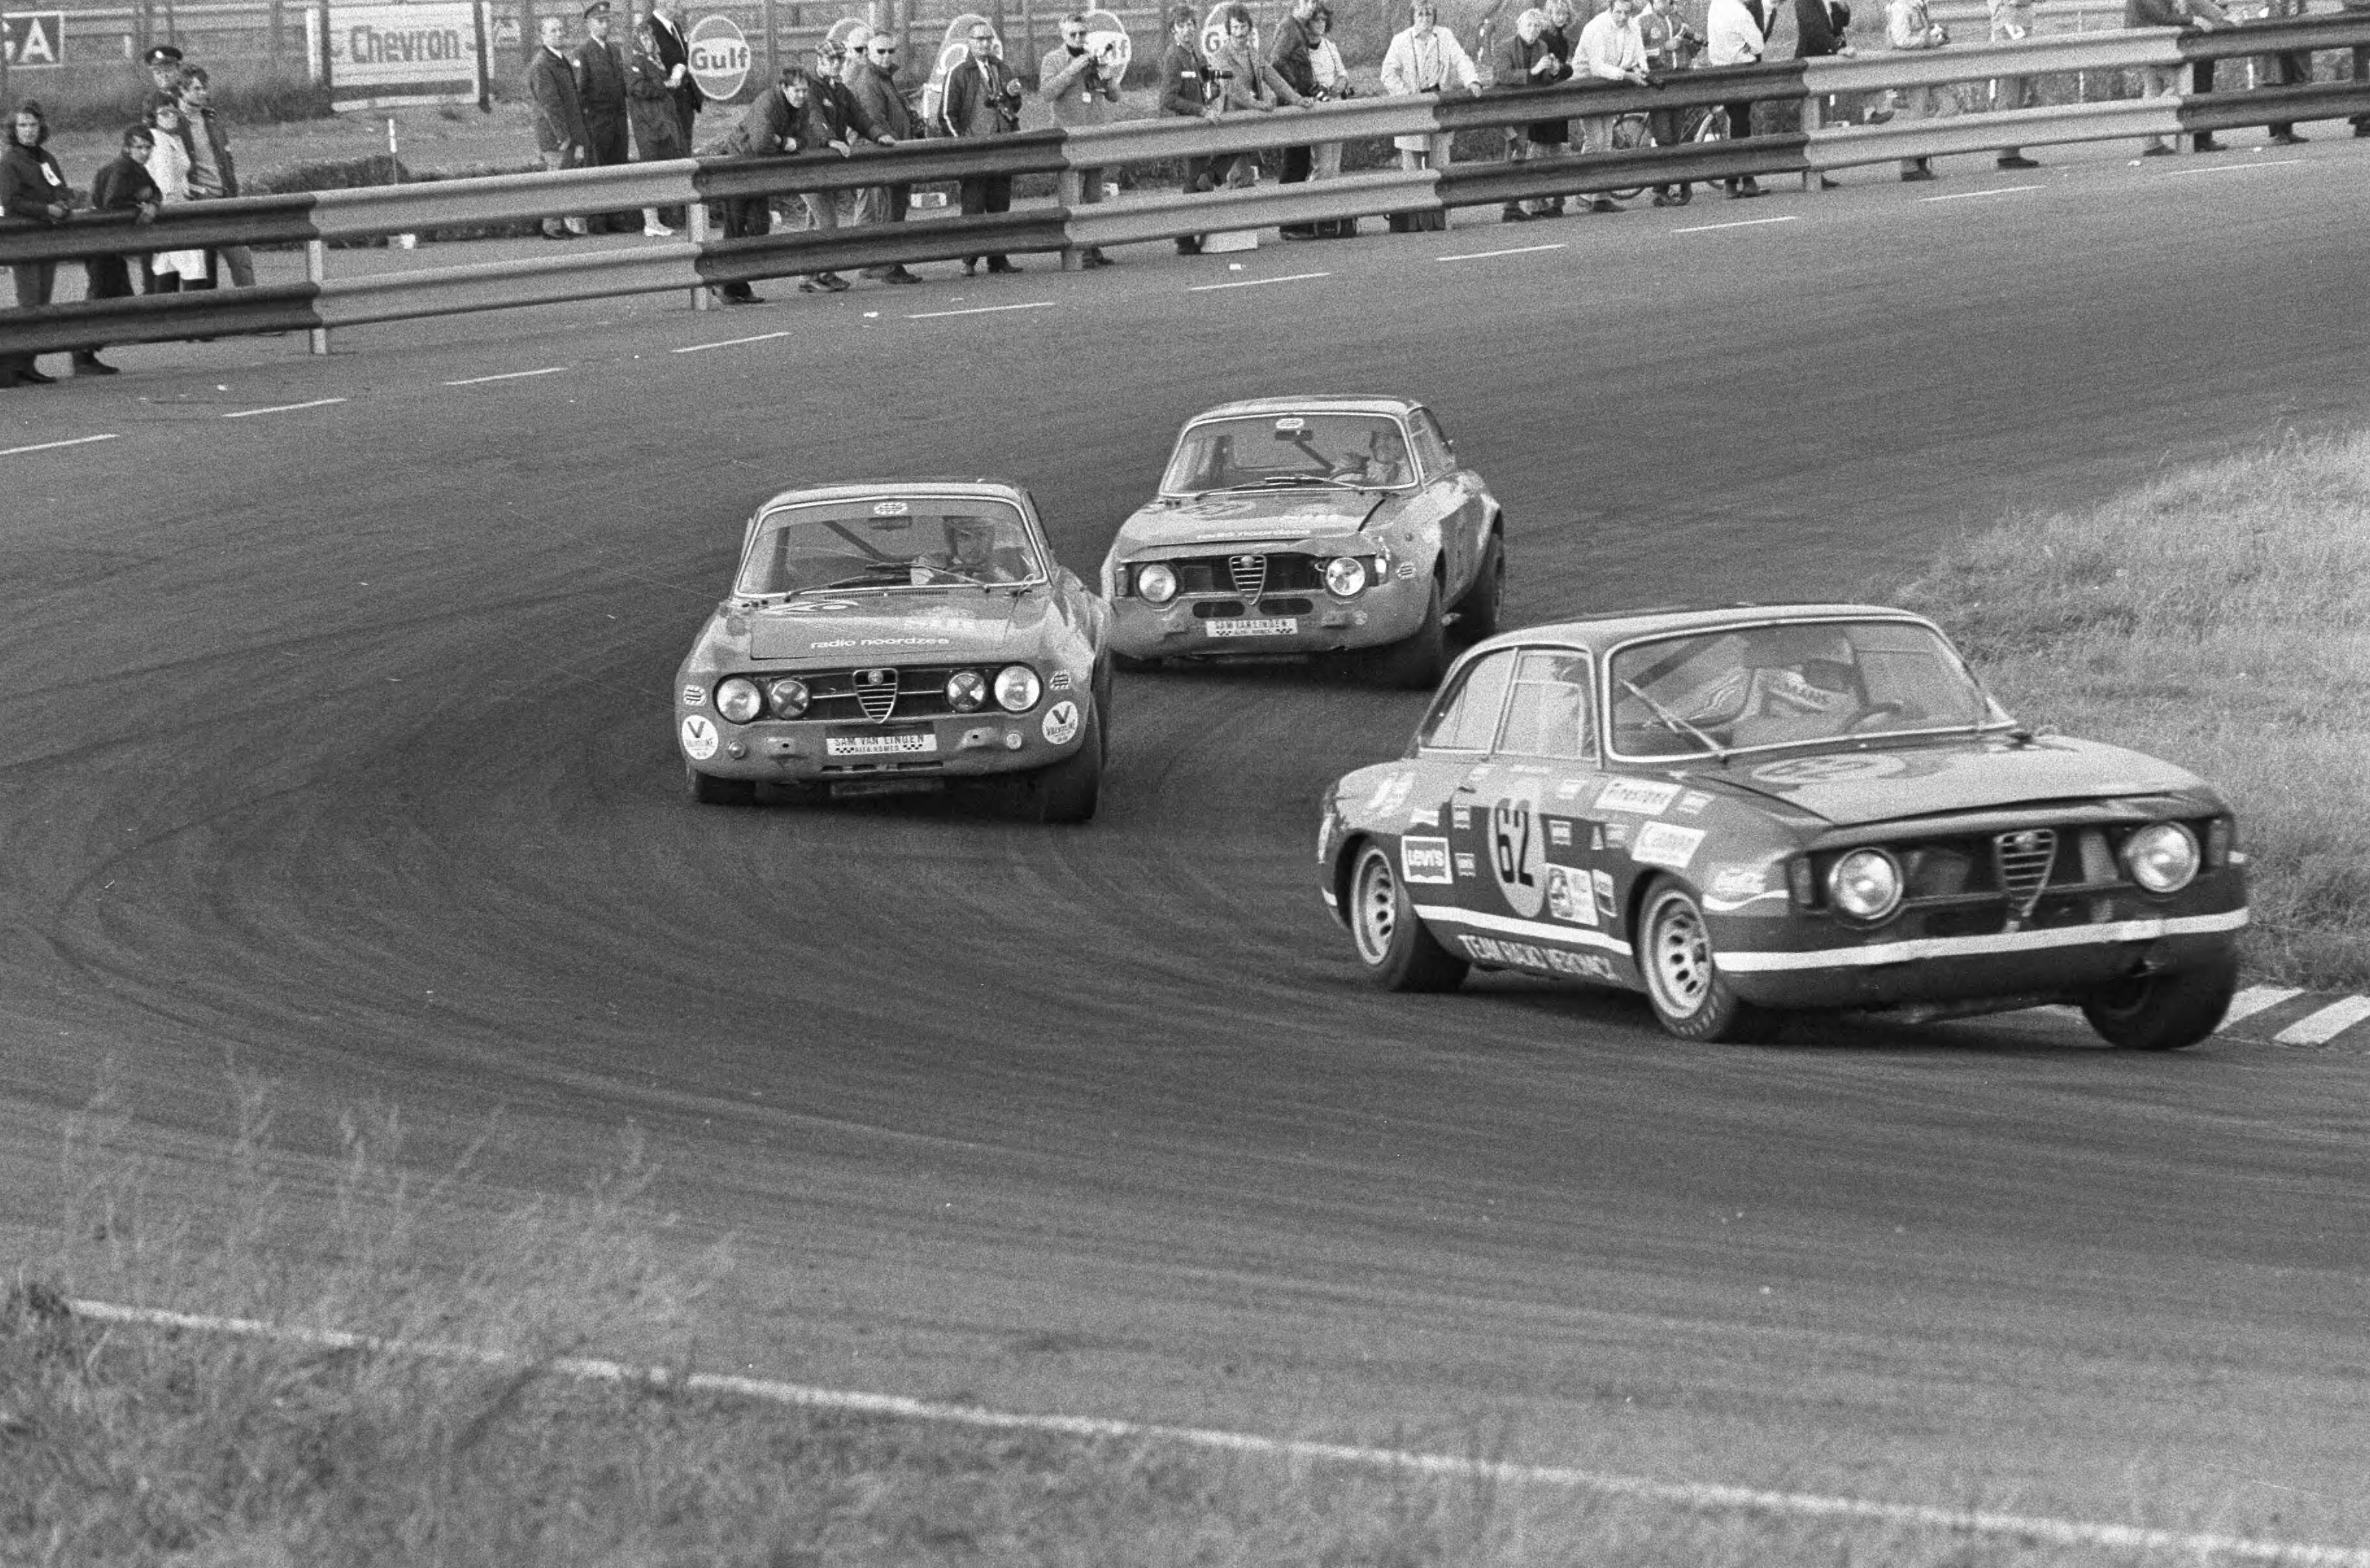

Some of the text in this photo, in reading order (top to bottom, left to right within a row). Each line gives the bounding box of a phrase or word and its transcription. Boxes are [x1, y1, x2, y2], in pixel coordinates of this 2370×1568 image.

[350, 25, 459, 64] Chevron
[691, 47, 748, 69] Gulf
[811, 637, 950, 649] radio noordzee
[1052, 705, 1072, 724] V
[687, 721, 706, 738] V
[1495, 798, 1534, 887] 62
[1457, 935, 1506, 962] TEAM
